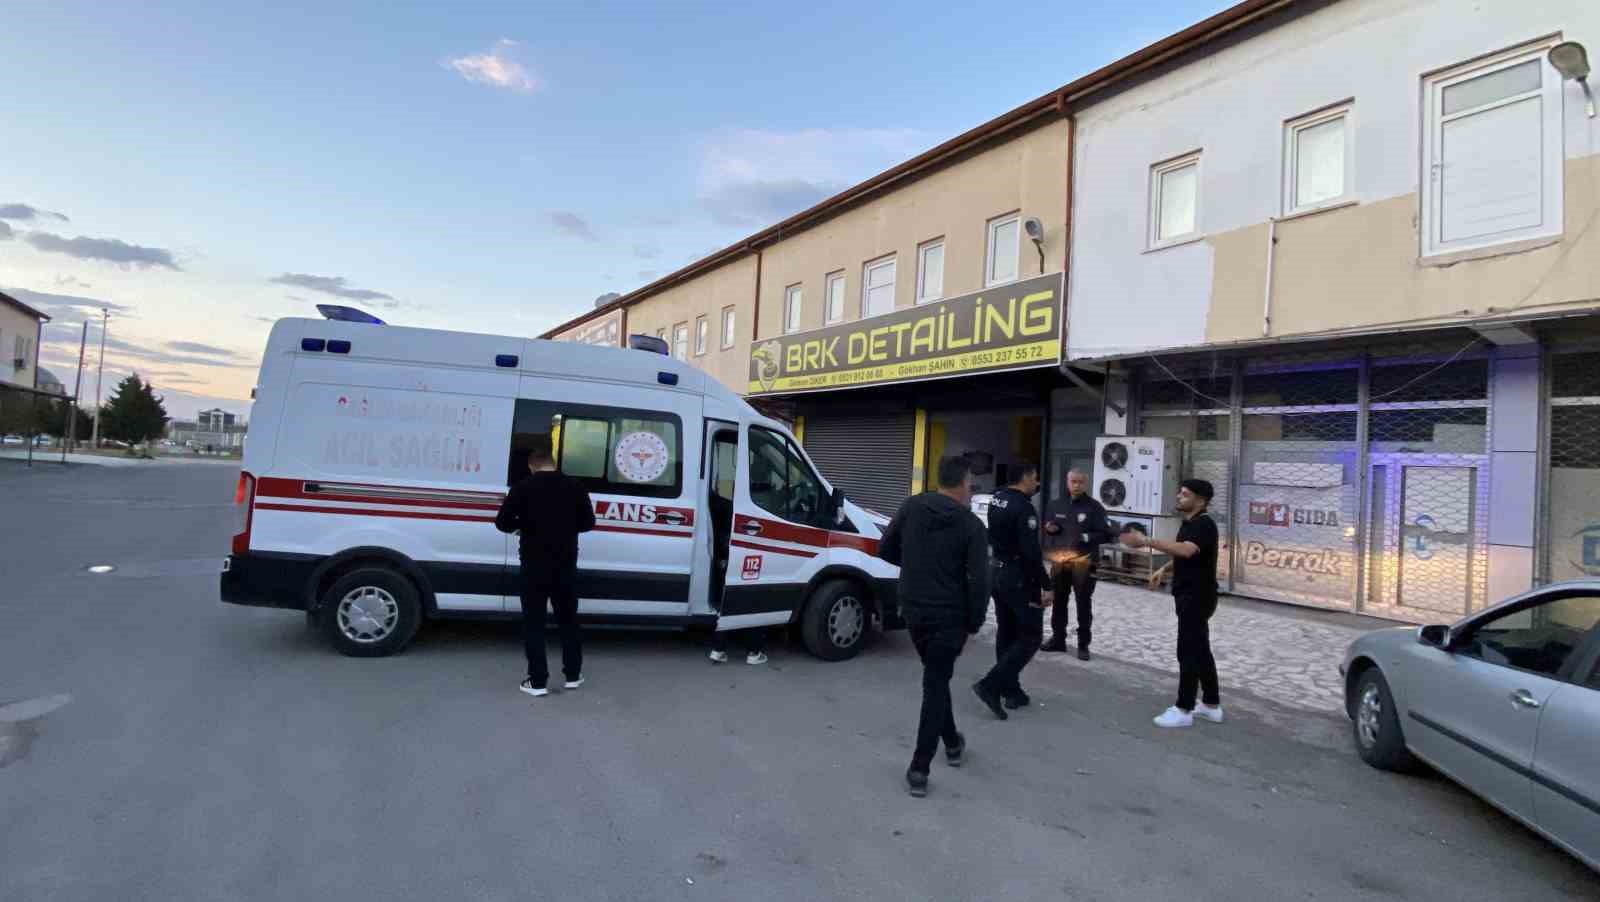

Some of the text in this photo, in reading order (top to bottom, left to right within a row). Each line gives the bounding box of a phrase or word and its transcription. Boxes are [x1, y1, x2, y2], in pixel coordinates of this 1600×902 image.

[786, 290, 1054, 373] BRK DETAİLİNG
[972, 353, 993, 365] 0553
[995, 350, 1012, 362] 237
[1016, 347, 1028, 360] 55
[1030, 345, 1043, 357] 72
[591, 501, 657, 523] LANS
[746, 558, 760, 570] 112
[1246, 540, 1343, 576] Berrak
